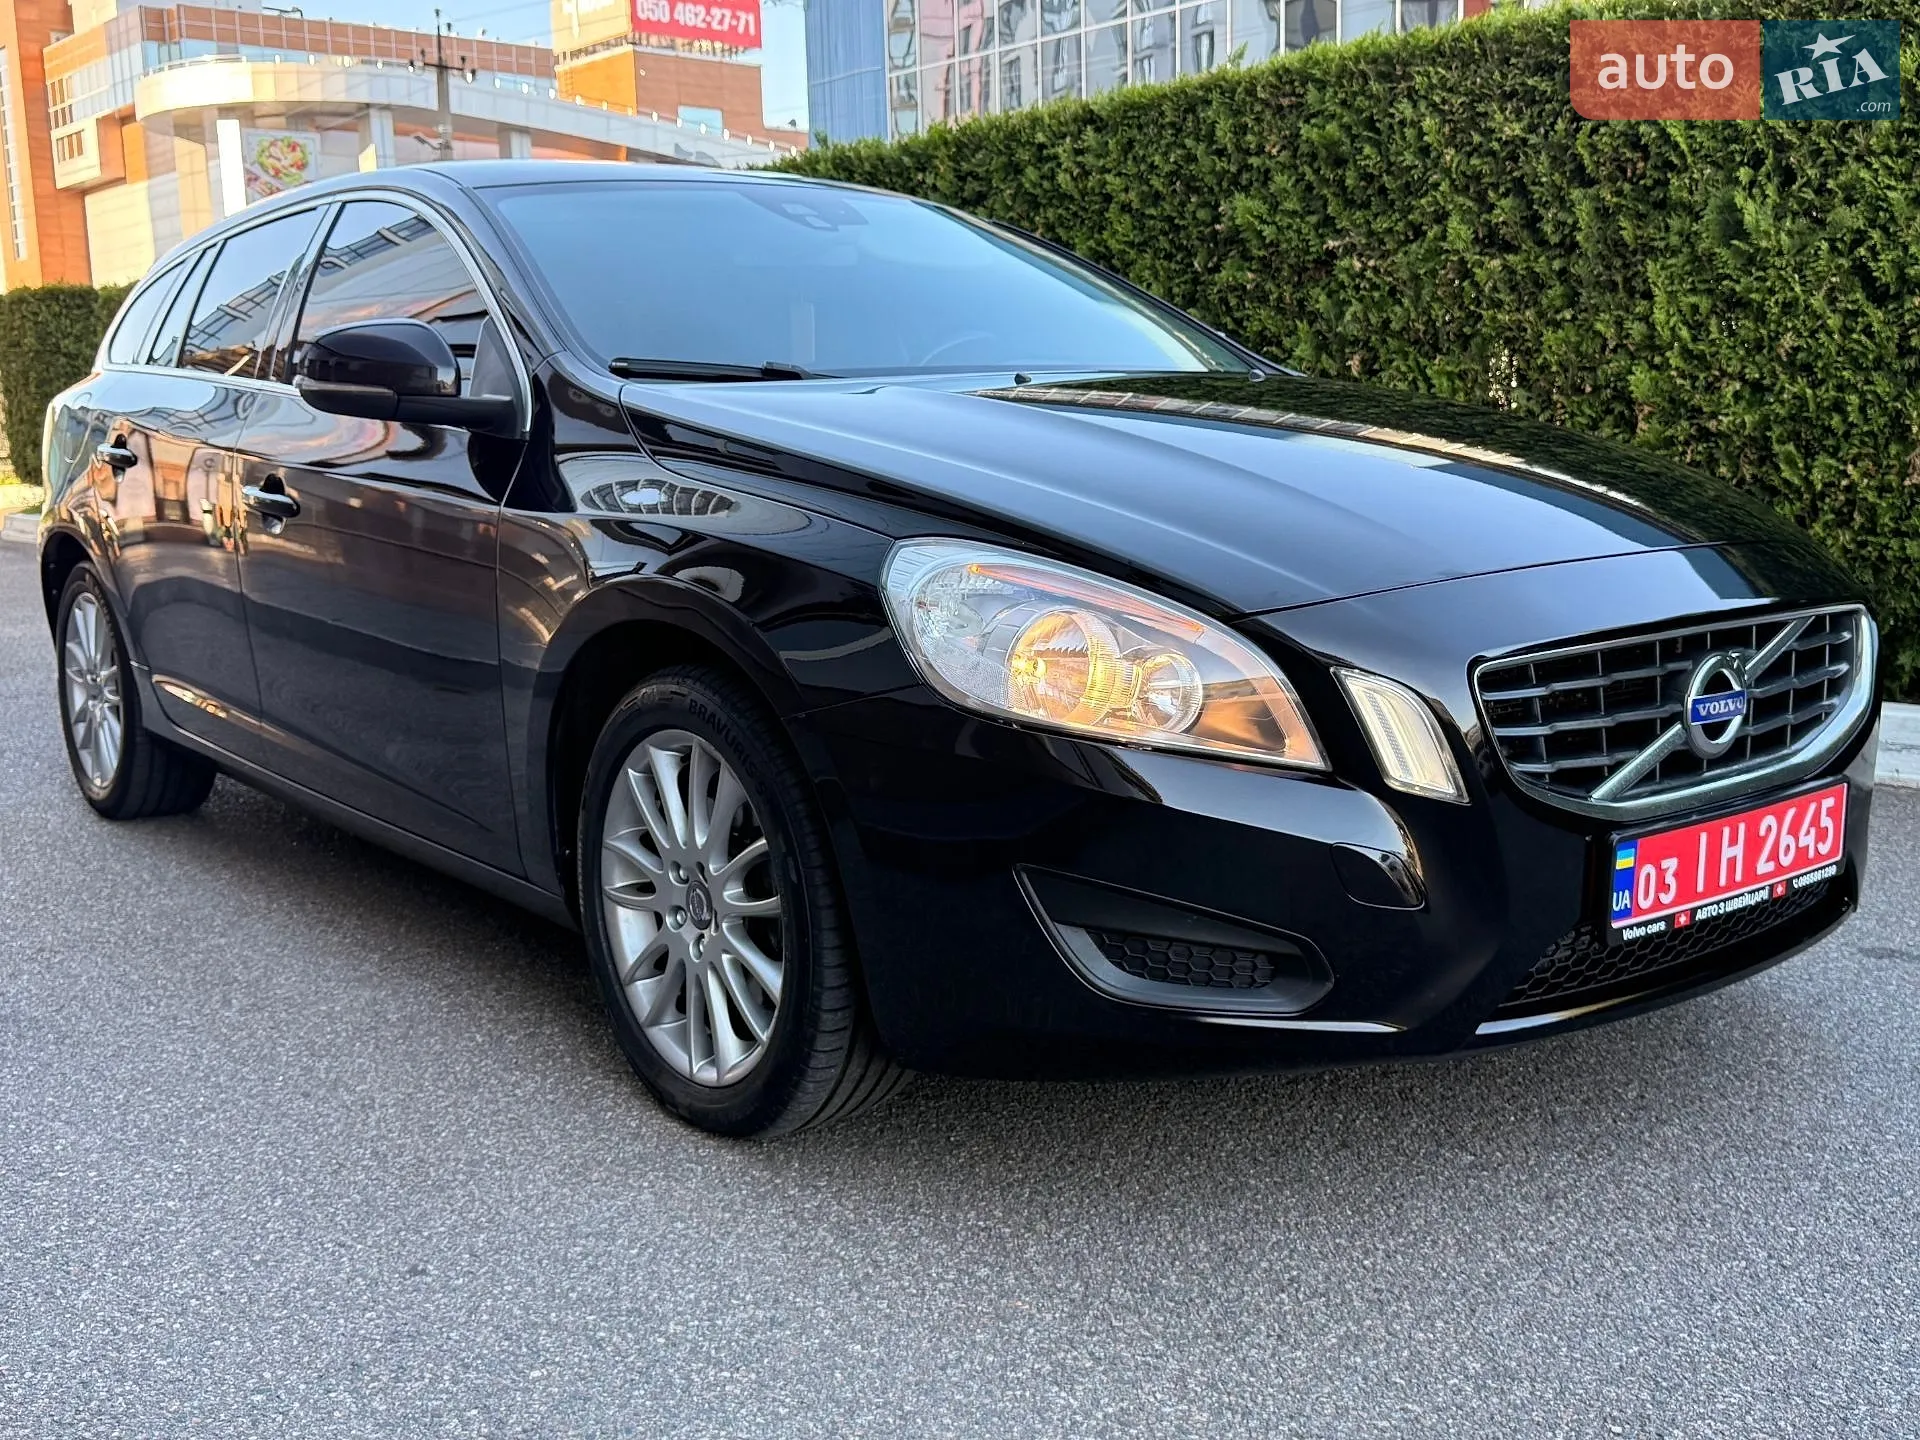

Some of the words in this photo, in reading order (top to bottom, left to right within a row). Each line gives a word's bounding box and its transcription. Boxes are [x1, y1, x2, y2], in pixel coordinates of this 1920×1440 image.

[635, 0, 671, 24] 050
[673, 2, 756, 37] 462-27-71
[1696, 696, 1744, 717] VOLVO
[688, 698, 758, 779] BRAVURIS
[1637, 857, 1678, 910] 03
[1697, 822, 1746, 893] IH
[1756, 797, 1835, 876] 2645
[1612, 889, 1631, 911] UA
[1695, 904, 1719, 921] АВТО
[1622, 925, 1646, 941] Volvo
[1647, 920, 1666, 934] cars
